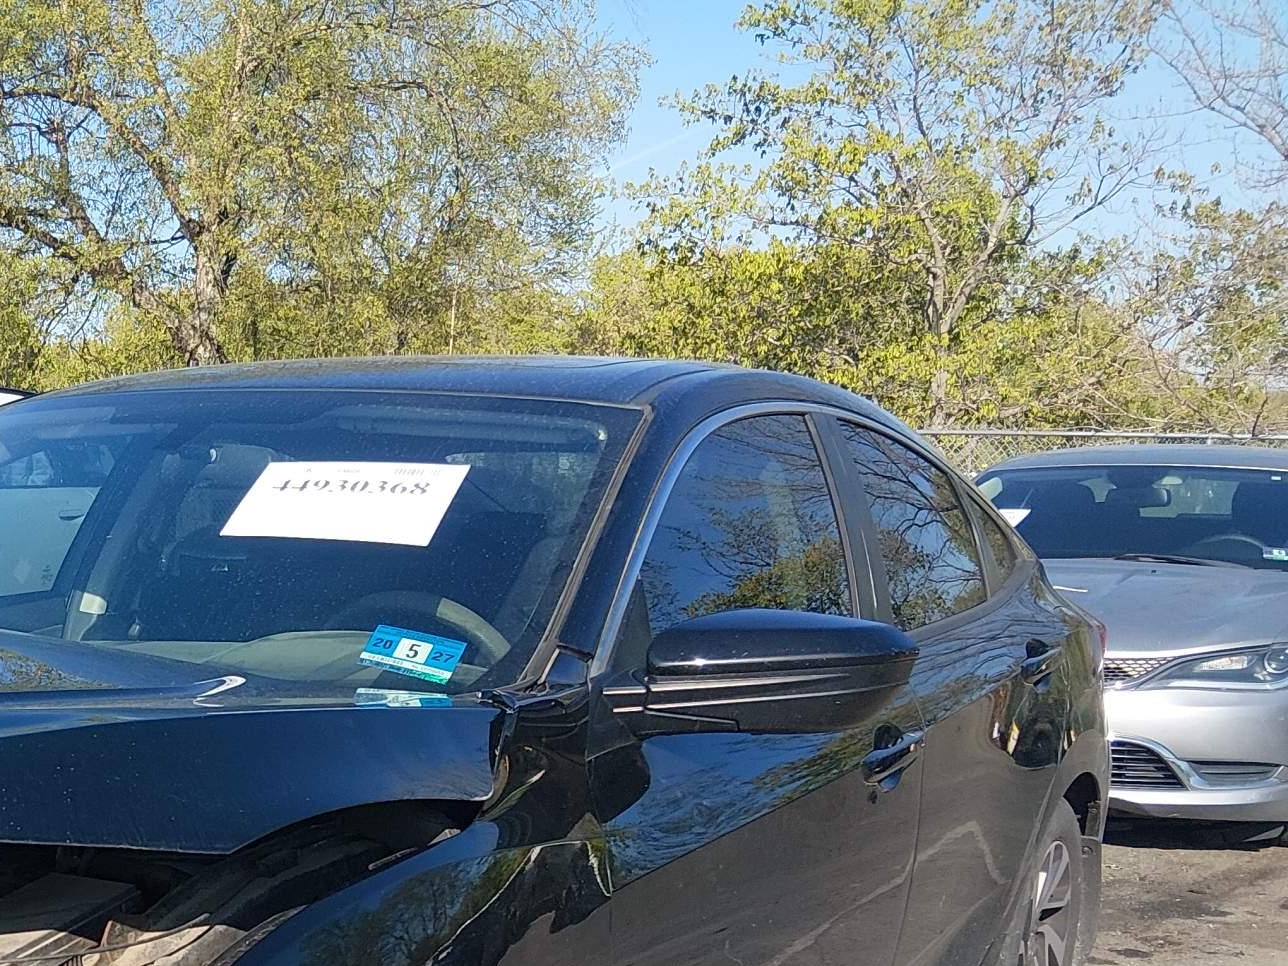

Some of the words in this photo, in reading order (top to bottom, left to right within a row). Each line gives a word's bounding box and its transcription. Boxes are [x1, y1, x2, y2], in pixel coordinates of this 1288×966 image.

[272, 479, 431, 495] 44930368
[373, 638, 393, 650] 20
[405, 643, 422, 659] 5
[431, 651, 455, 664] 27
